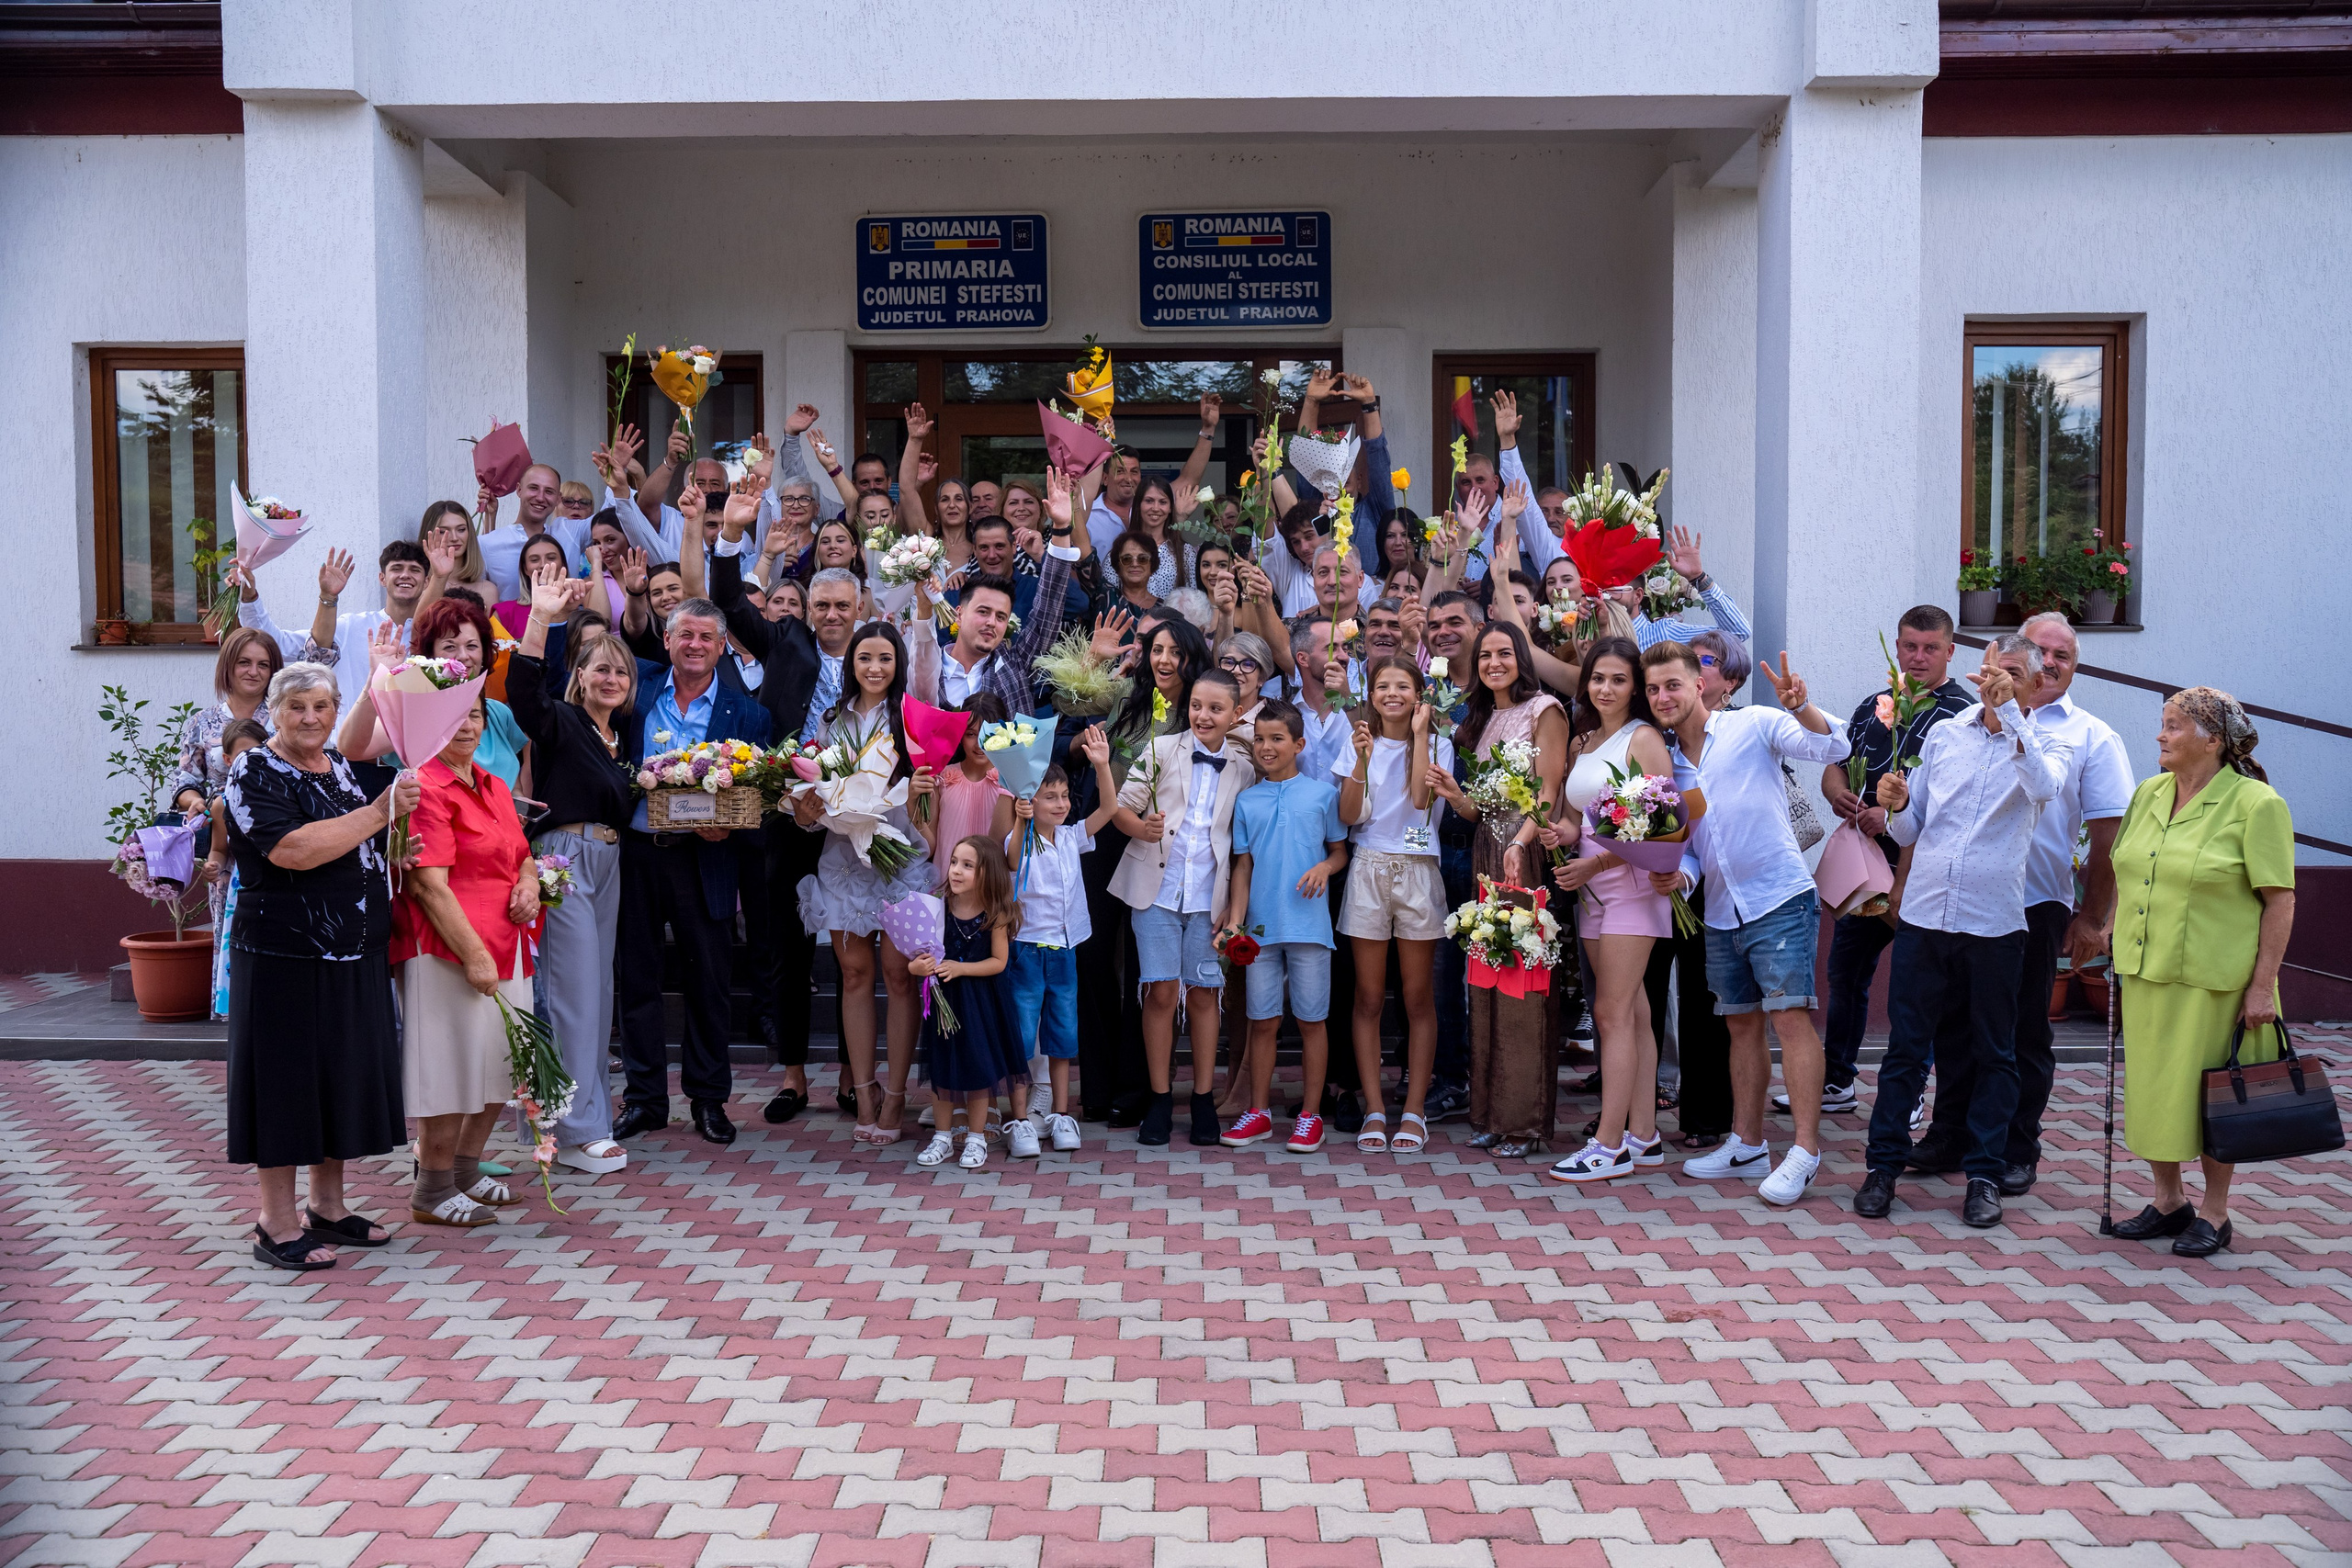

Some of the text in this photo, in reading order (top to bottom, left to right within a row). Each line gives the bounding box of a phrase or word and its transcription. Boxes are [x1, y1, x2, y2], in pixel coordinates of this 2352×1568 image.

[901, 220, 1001, 237] ROMANIA
[1185, 217, 1285, 234] ROMANIA
[888, 259, 1014, 279] PRIMARIA
[1153, 253, 1317, 269] CONSILIUL LOCAL
[1227, 271, 1242, 279] AL
[863, 284, 1042, 306] COMUNEI STEFESTI
[1153, 281, 1318, 300] COMUNEI STEFESTI
[870, 309, 1035, 323] JUDETUL PRAHOVA
[1153, 306, 1319, 321] JUDETUL PRAHOVA
[674, 799, 710, 814] Flowers
